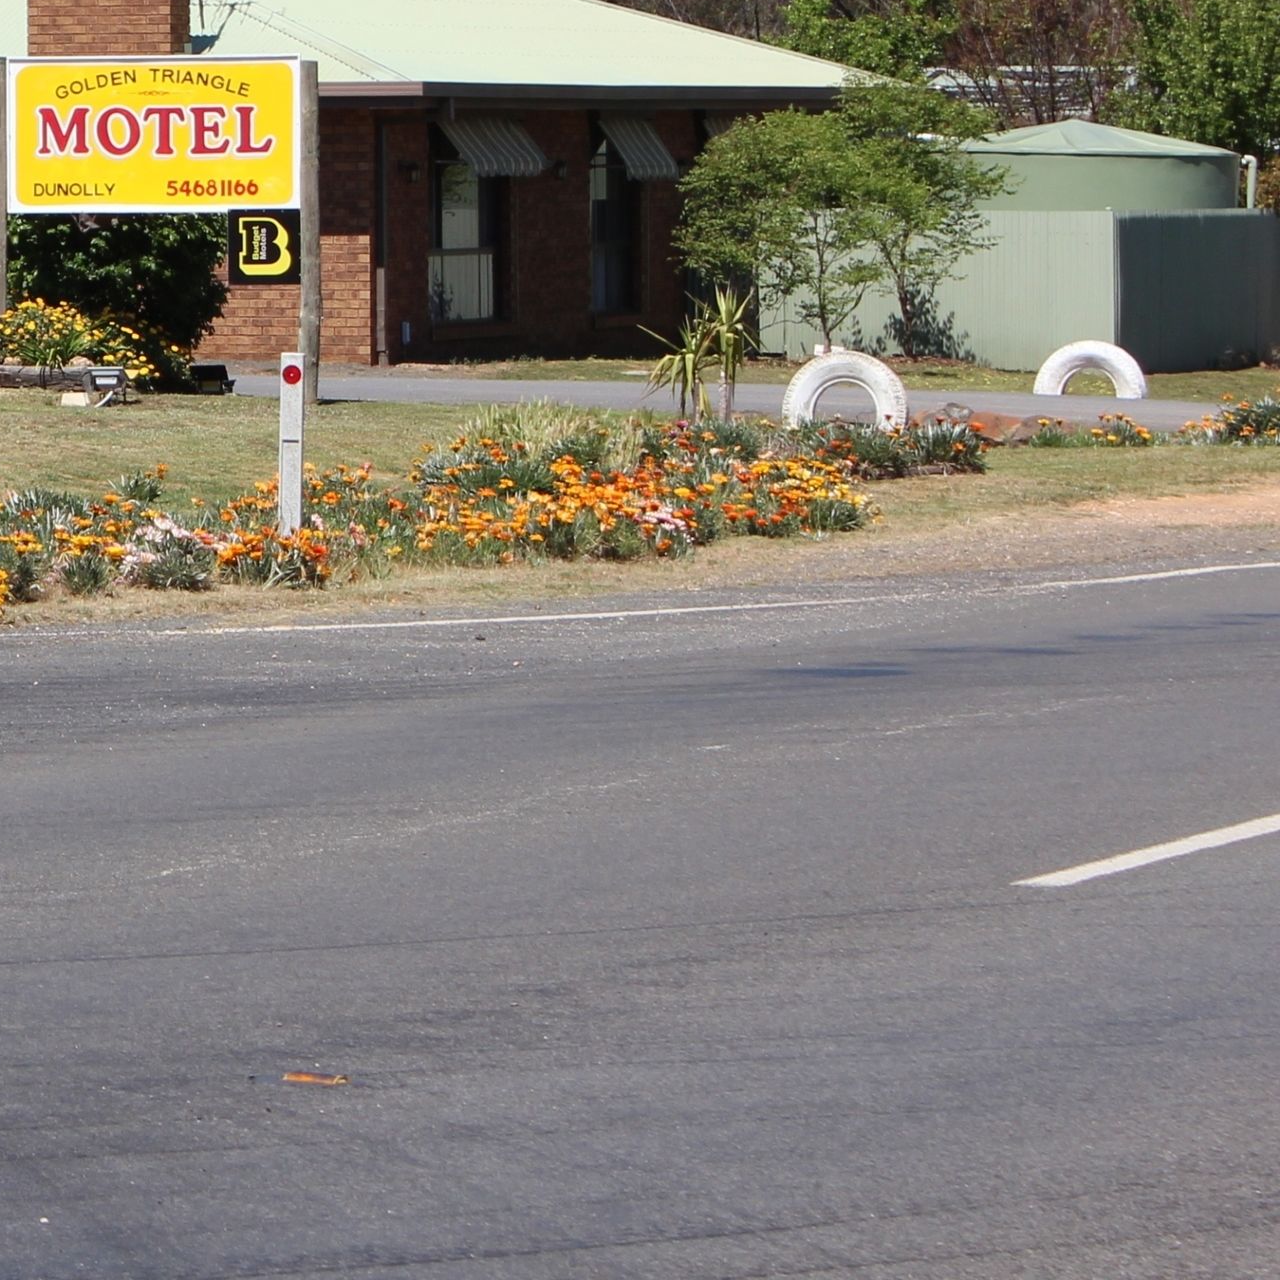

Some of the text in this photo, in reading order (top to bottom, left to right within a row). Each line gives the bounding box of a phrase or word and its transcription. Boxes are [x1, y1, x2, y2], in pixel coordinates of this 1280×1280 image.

[54, 68, 252, 100] GOLDEN TRIANGLE
[37, 106, 273, 157] MOTEL
[33, 182, 116, 197] DUNOLLY
[252, 225, 260, 260] Budget
